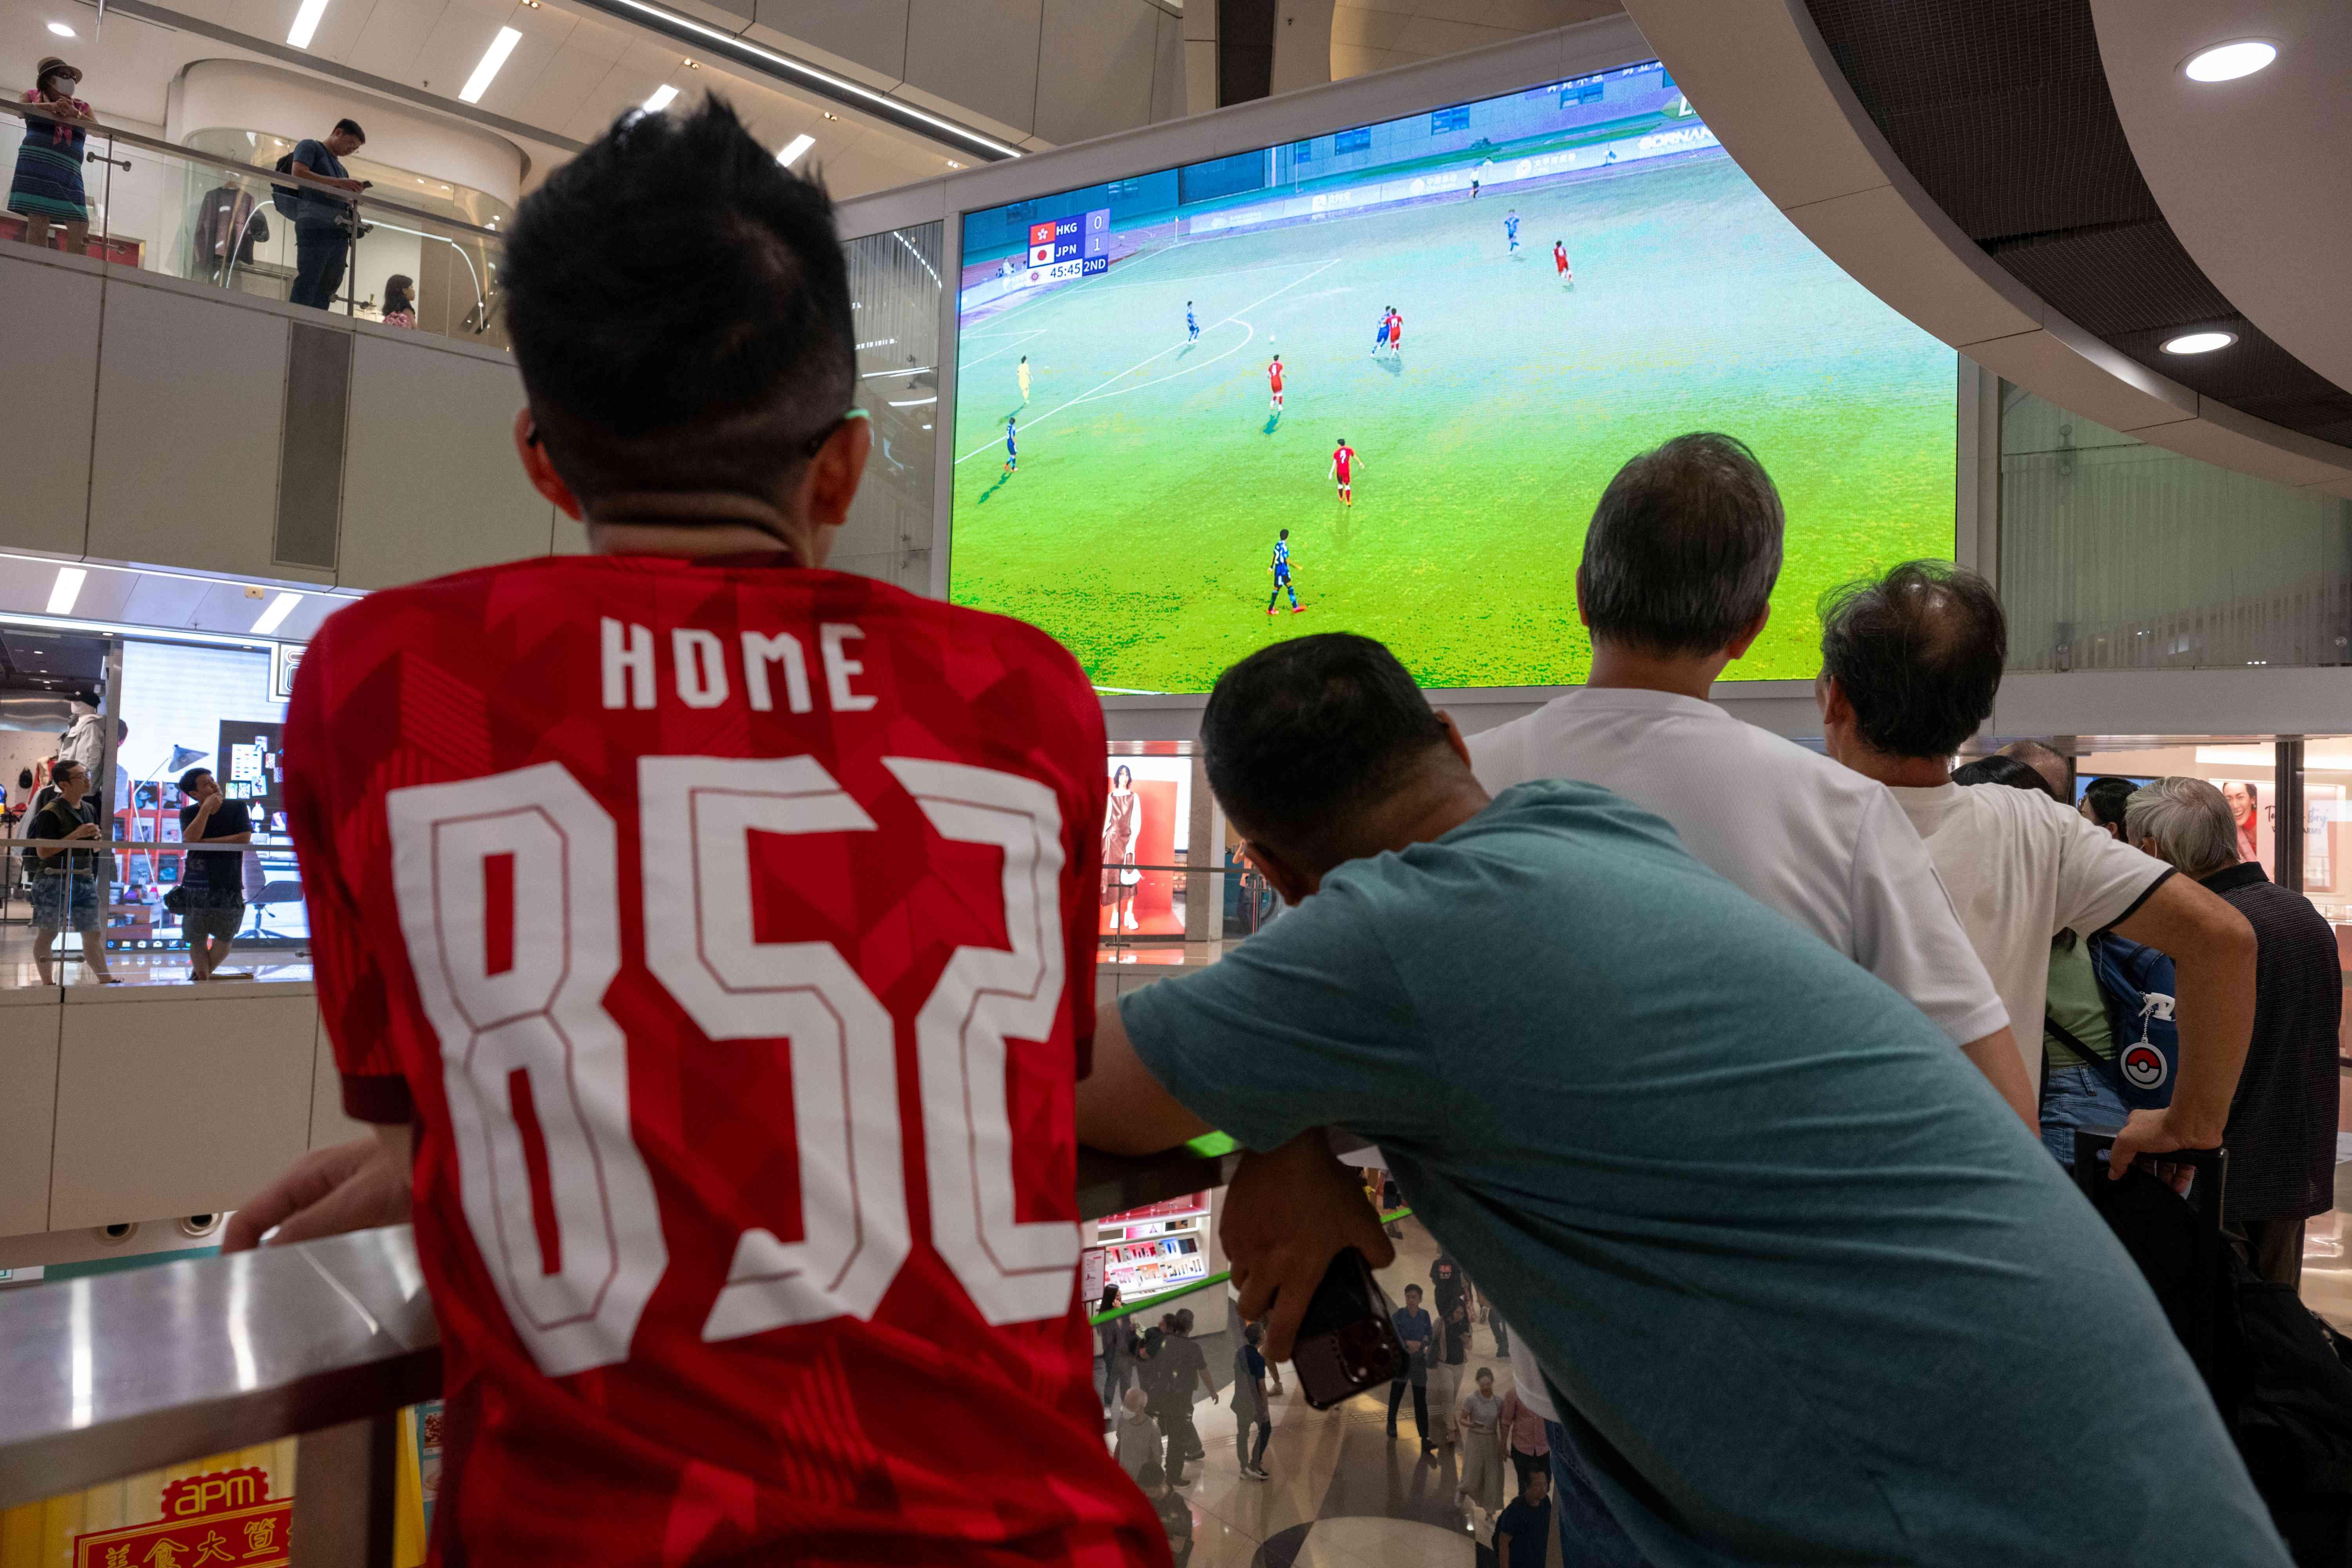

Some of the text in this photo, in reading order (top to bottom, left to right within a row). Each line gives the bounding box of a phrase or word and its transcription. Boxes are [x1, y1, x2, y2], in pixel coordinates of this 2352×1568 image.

[1056, 216, 1102, 236] HKG 0
[1056, 238, 1100, 257] JPN 1
[1050, 258, 1106, 278] 45:45 2ND
[600, 615, 879, 714] HOME
[386, 753, 1082, 1377] 852
[105, 1516, 294, 1568] 美食大笪
